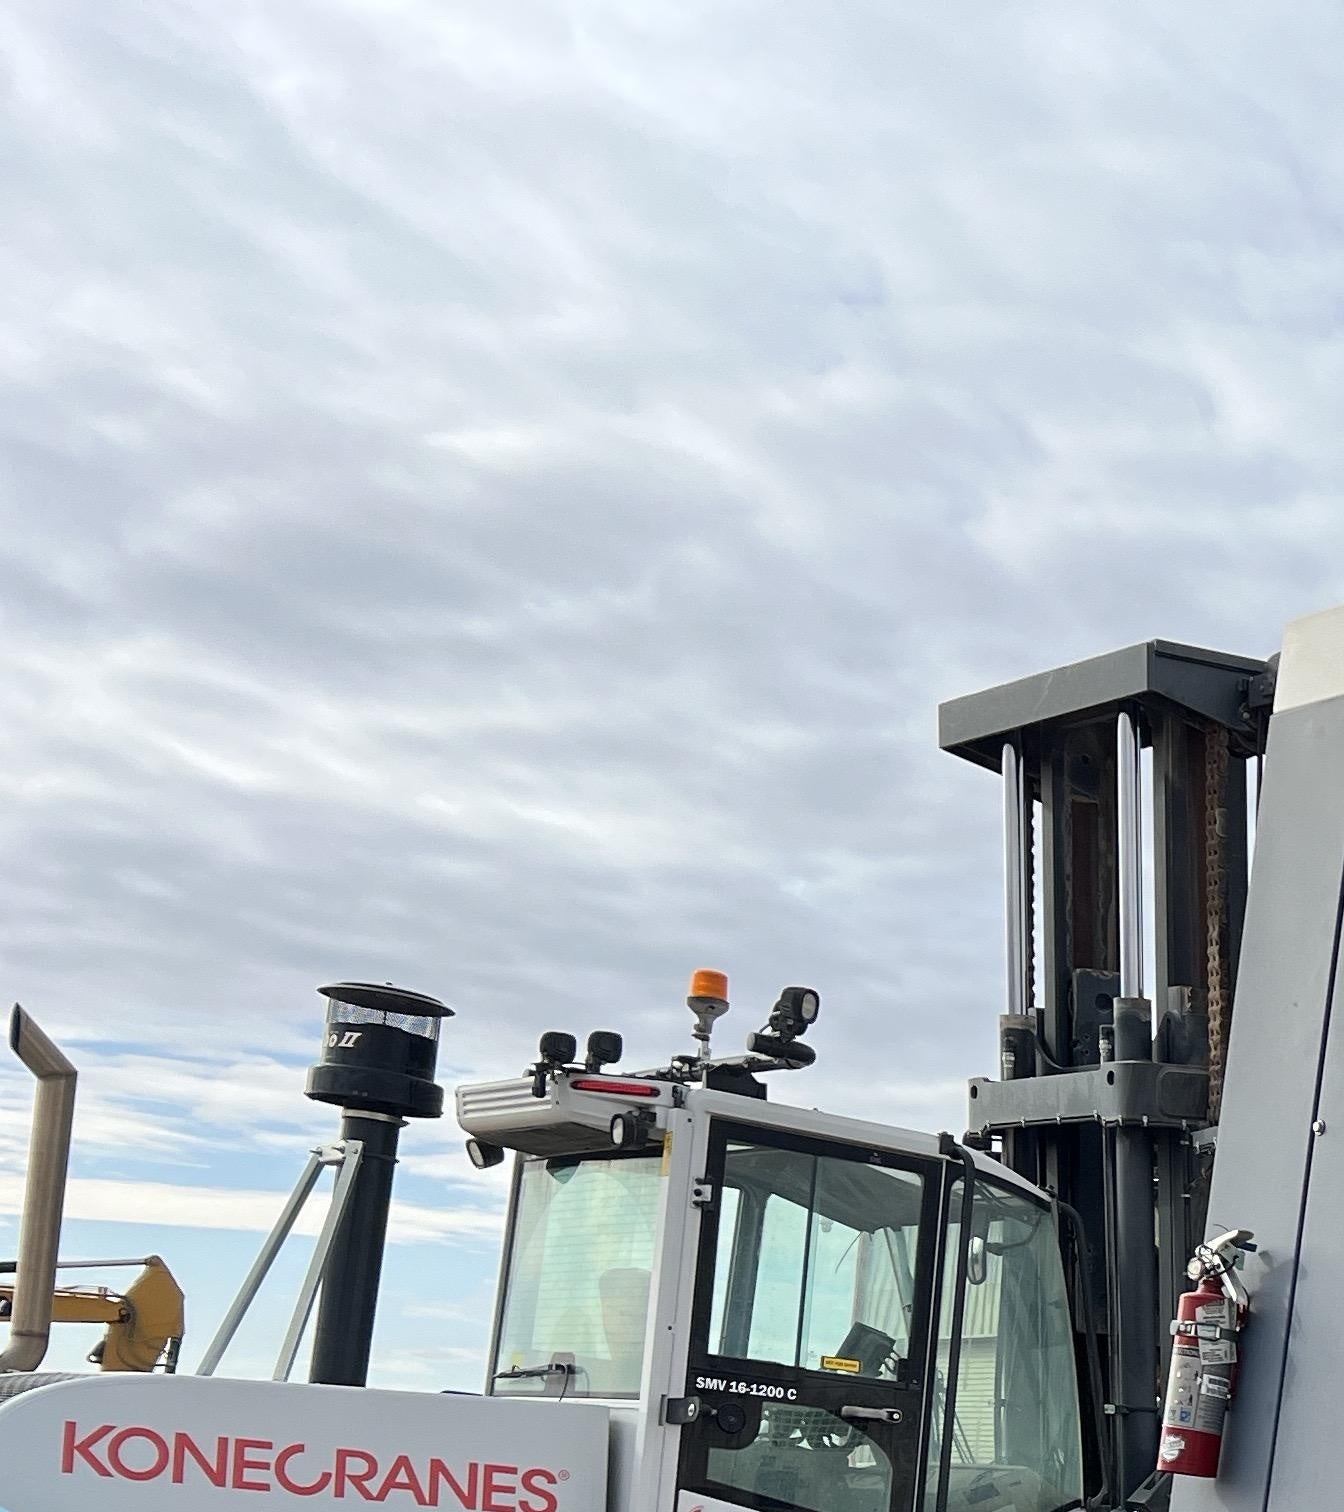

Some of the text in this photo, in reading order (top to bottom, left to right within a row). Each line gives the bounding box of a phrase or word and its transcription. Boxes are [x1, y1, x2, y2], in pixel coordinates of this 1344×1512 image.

[695, 1376, 798, 1400] SMV 16-1200 C
